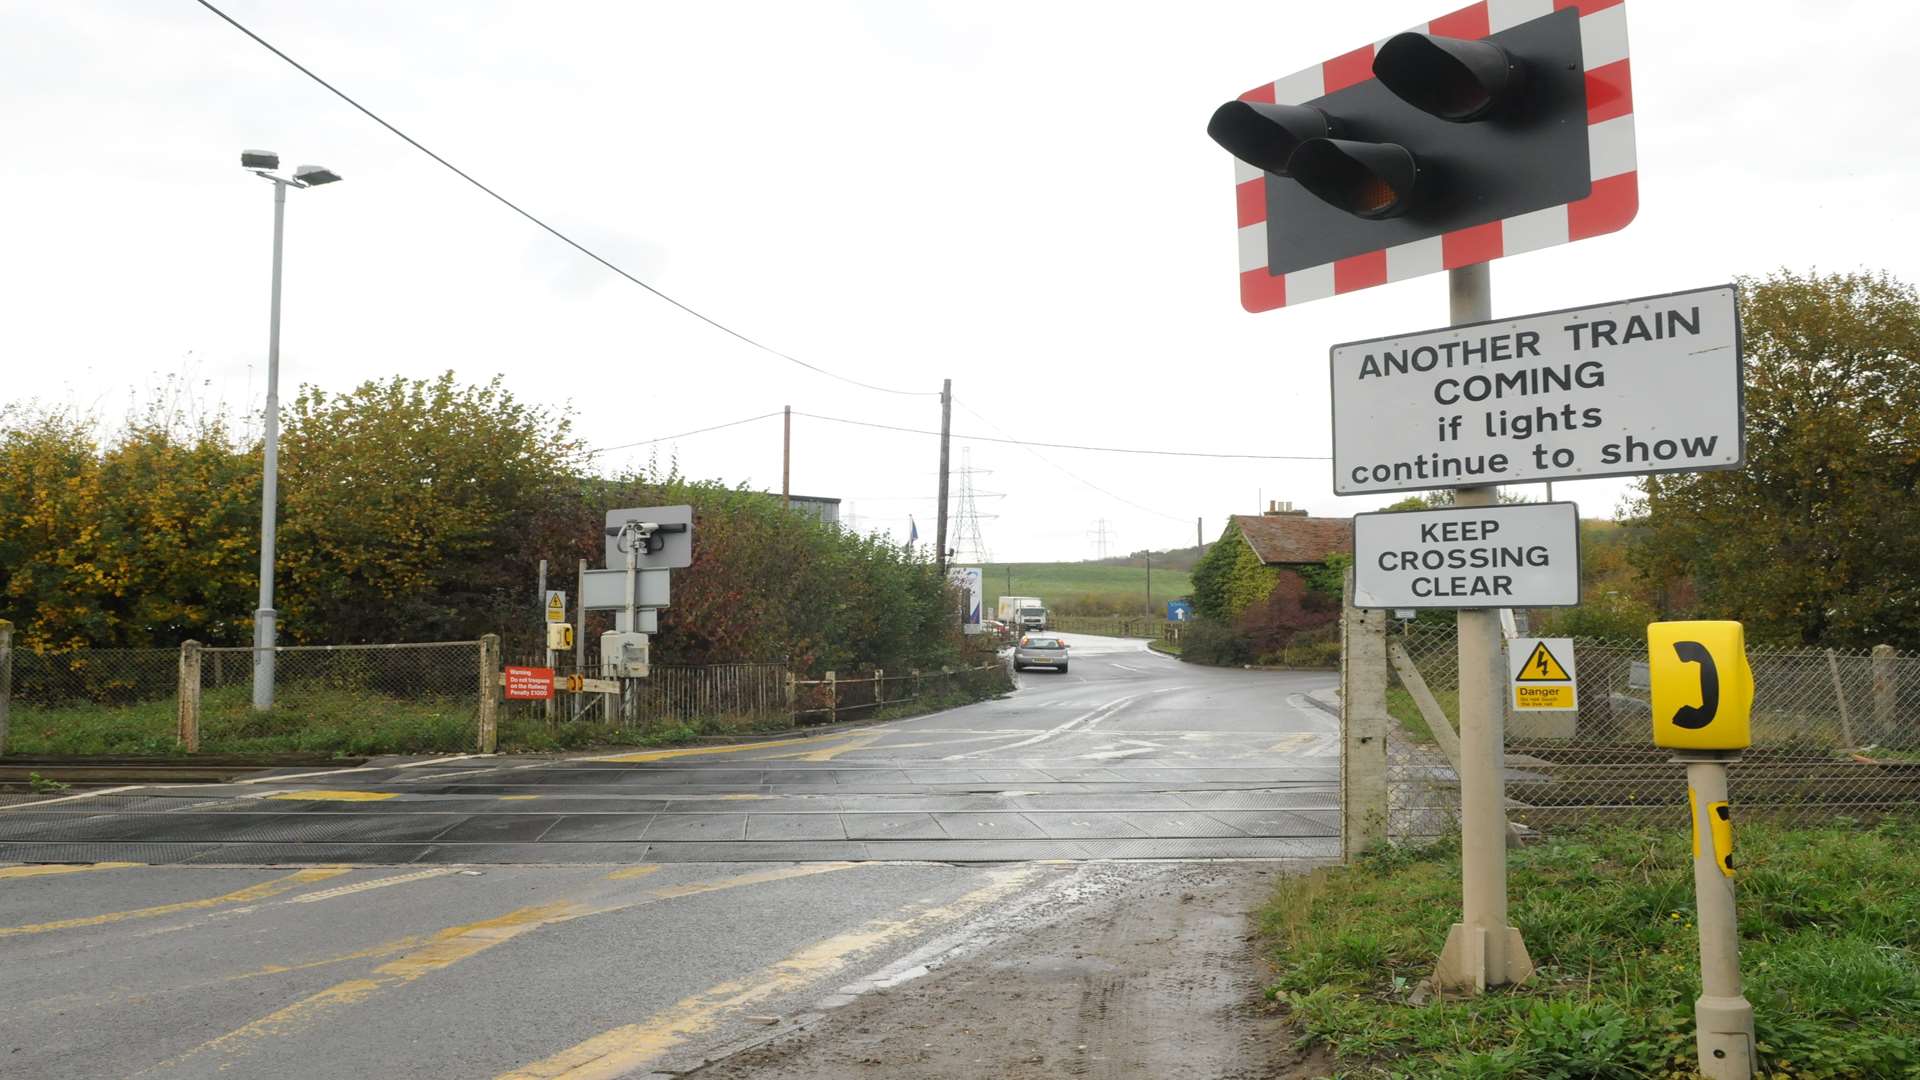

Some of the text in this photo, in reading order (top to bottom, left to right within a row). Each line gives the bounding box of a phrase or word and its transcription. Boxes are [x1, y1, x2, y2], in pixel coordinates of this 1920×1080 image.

[1358, 306, 1700, 380] ANOTHER TRAIN
[1433, 361, 1605, 405] COMING
[1438, 404, 1602, 441] if lights
[1351, 435, 1718, 484] continue to show
[1421, 519, 1500, 543] KEEP
[1378, 545, 1549, 571] CROSSING
[1411, 575, 1512, 597] CLEAR
[1519, 687, 1560, 697] Danger
